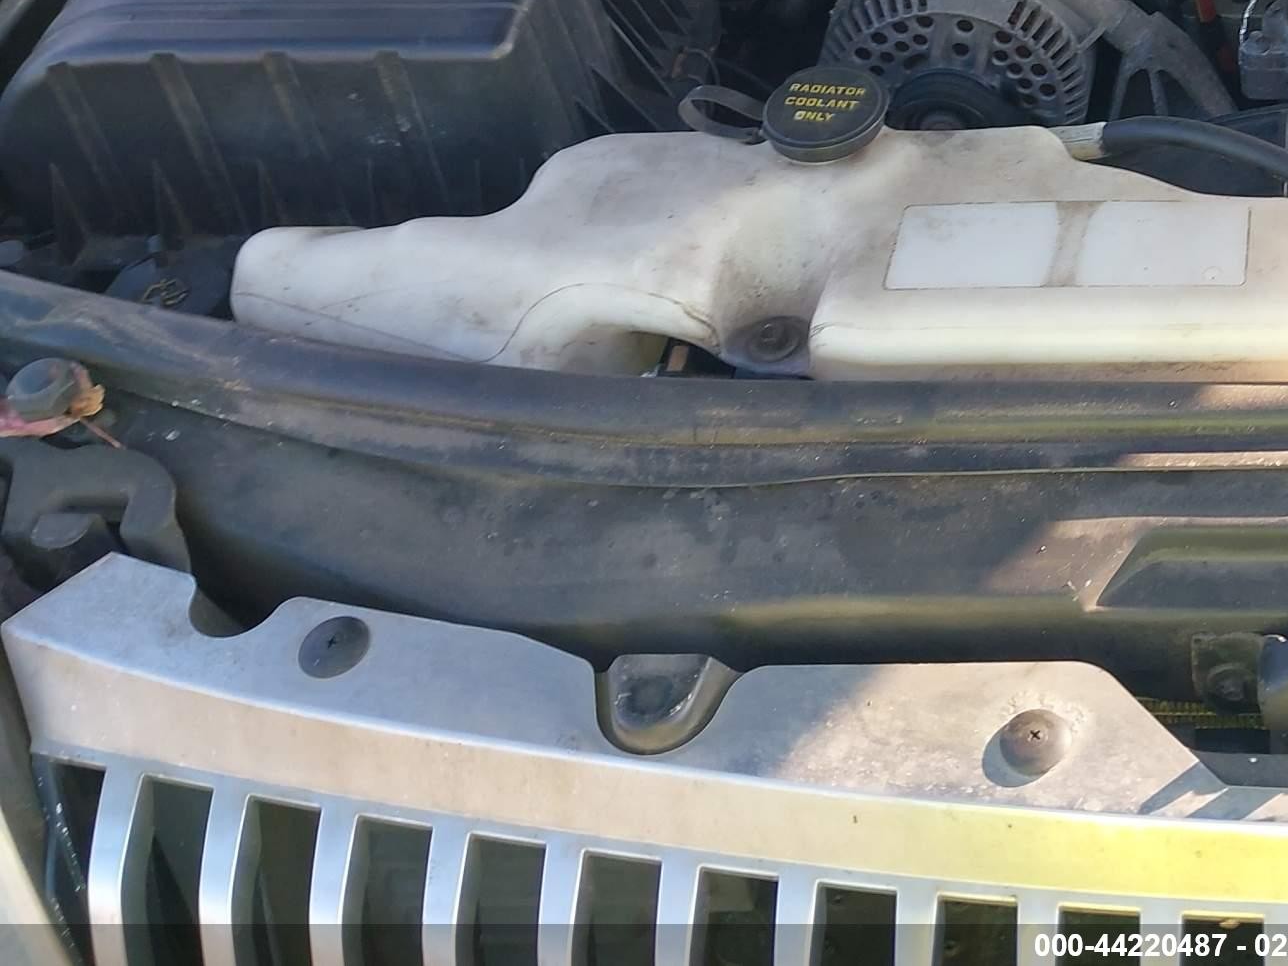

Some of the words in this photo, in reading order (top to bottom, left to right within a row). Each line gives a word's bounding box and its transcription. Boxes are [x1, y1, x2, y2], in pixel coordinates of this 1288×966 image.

[789, 82, 867, 96] RADIATOR
[784, 96, 860, 111] COOLANT
[793, 110, 835, 122] ONLY
